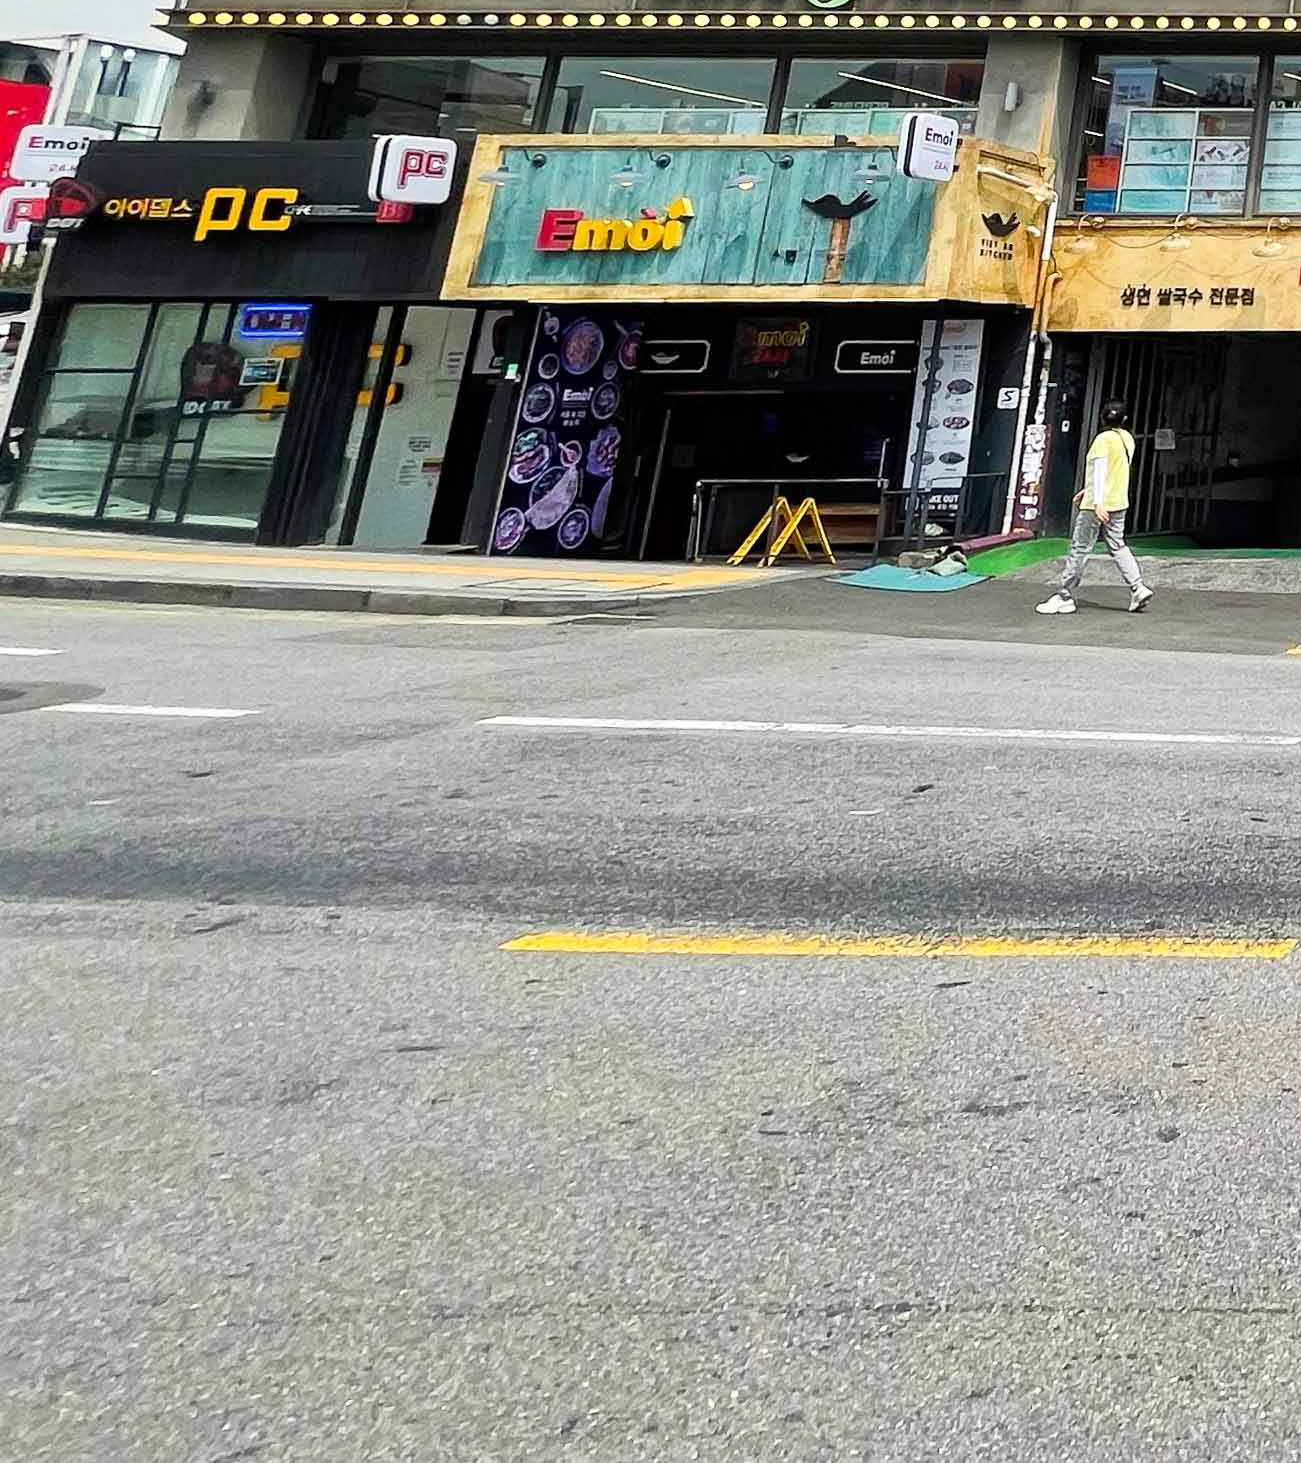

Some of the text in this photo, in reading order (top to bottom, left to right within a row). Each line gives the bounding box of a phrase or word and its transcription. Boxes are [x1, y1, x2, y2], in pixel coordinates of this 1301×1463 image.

[1120, 283, 1256, 307] 생면 쌀국수 전문점
